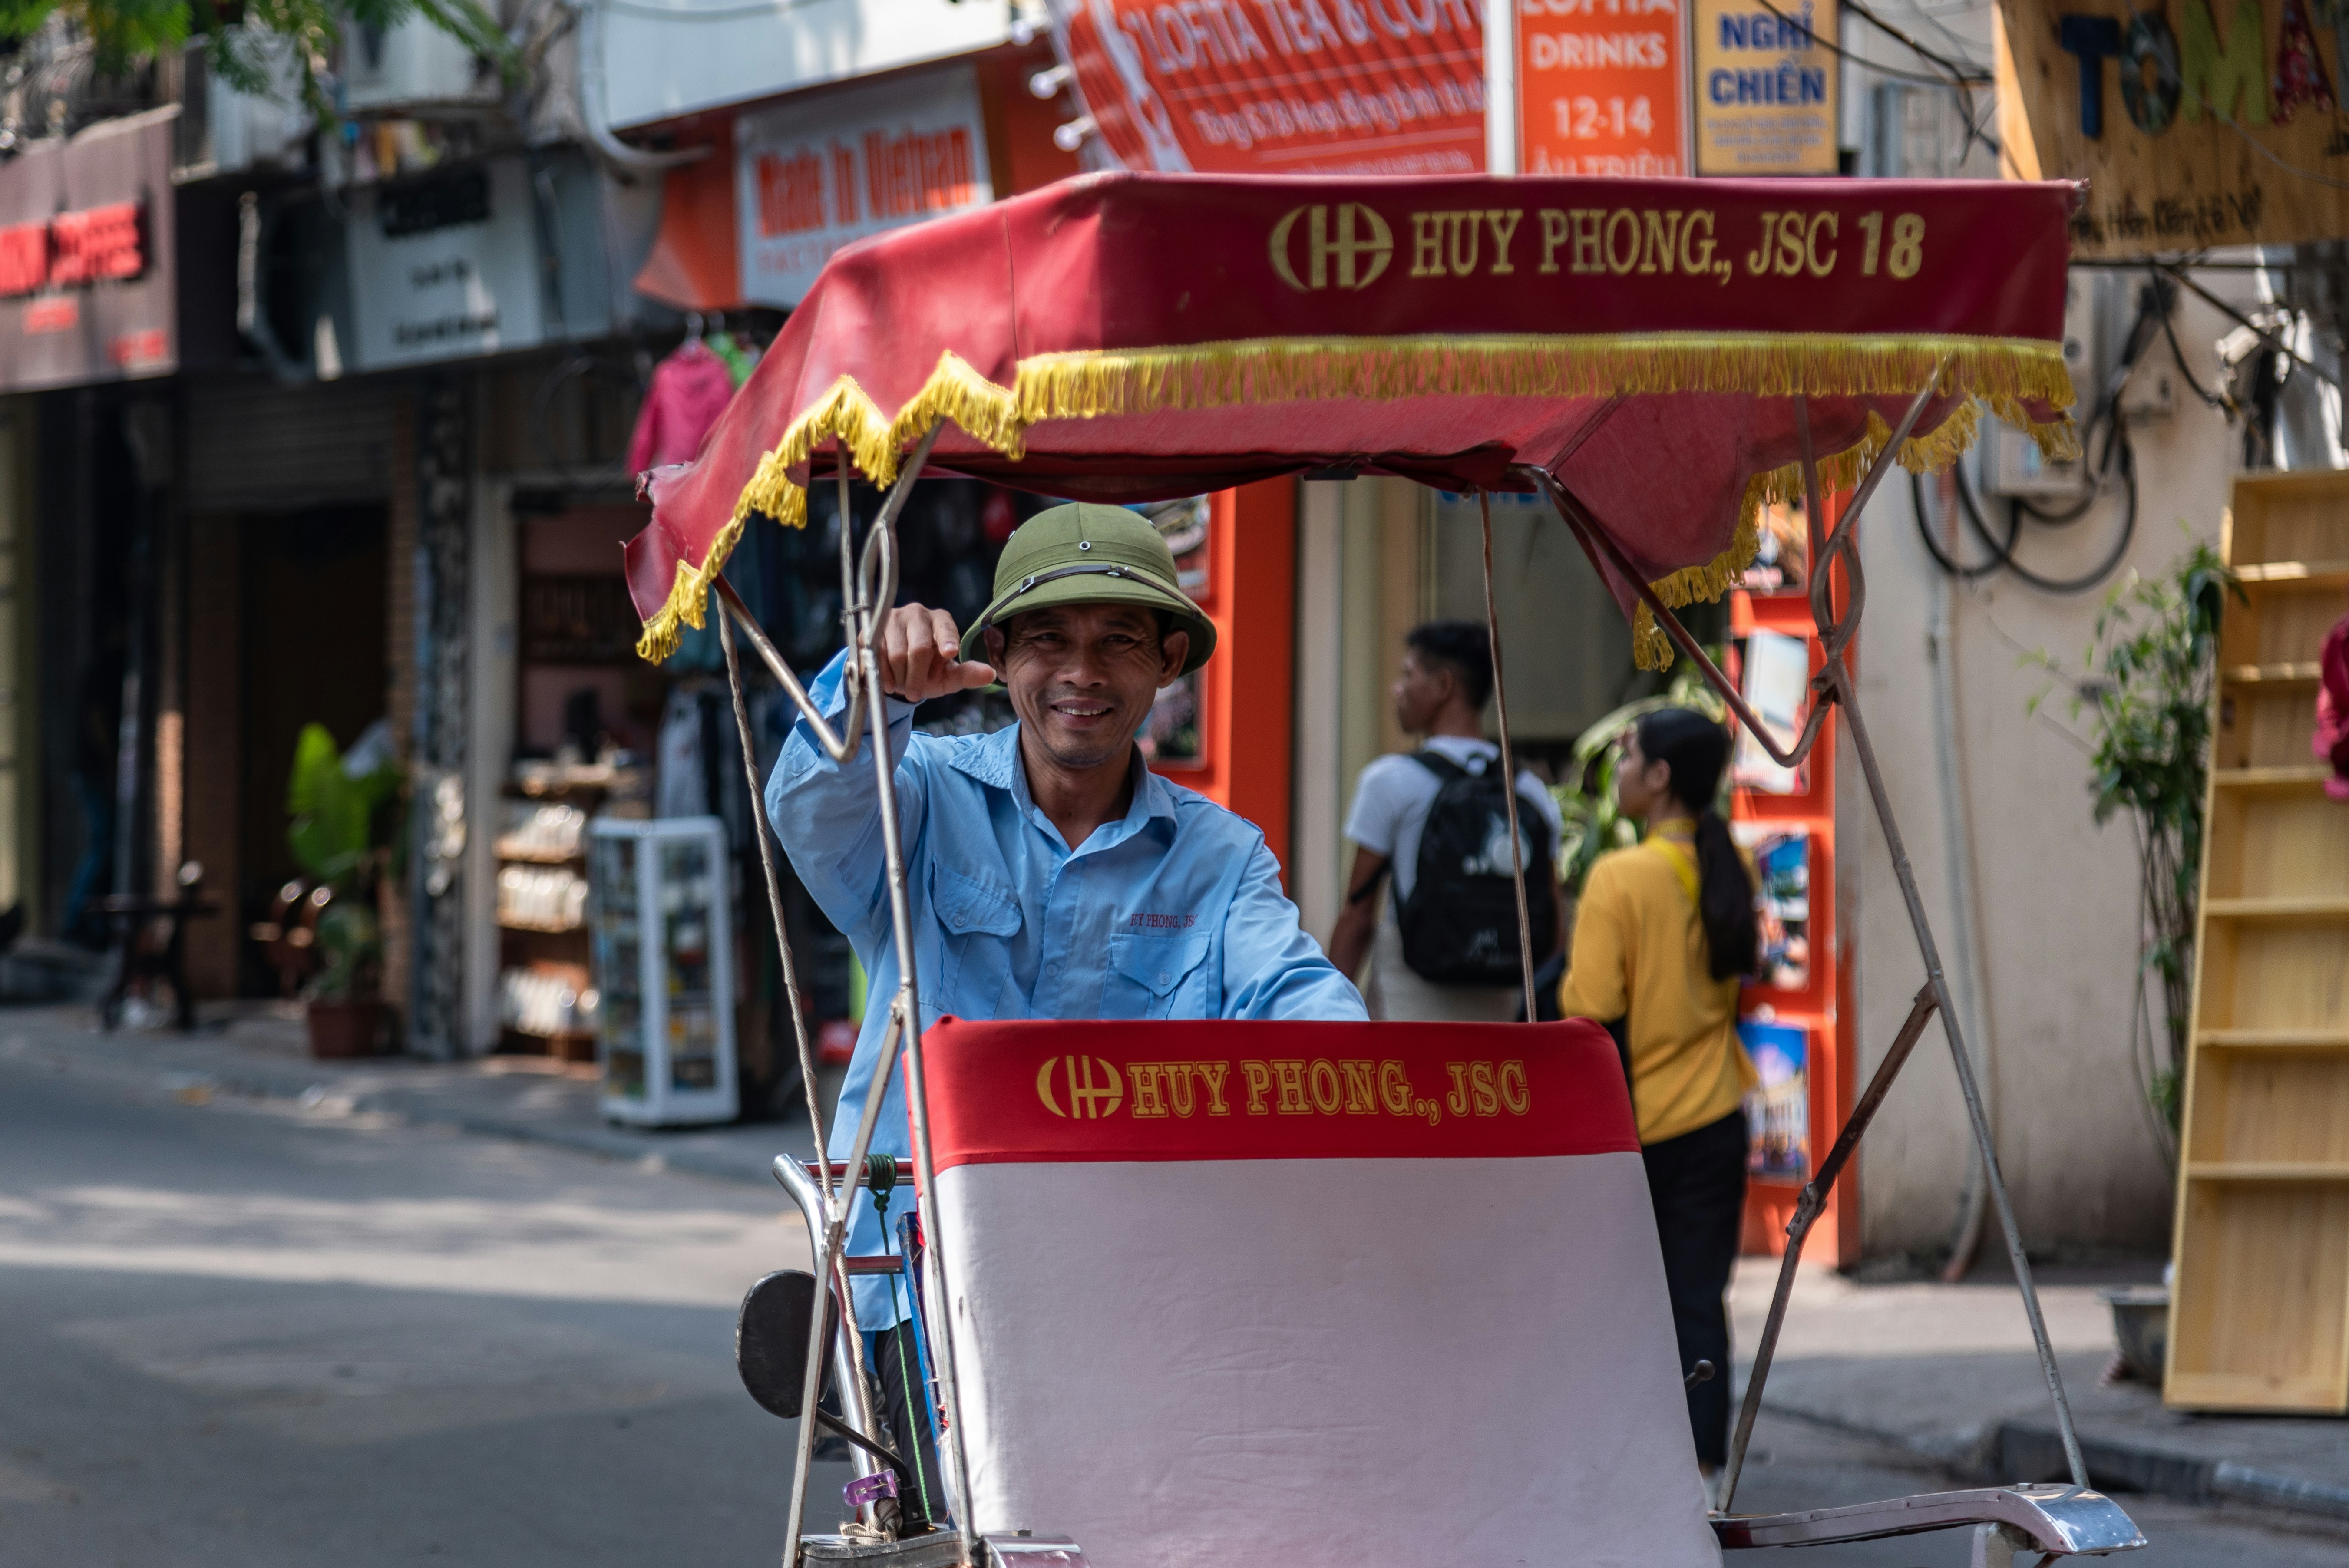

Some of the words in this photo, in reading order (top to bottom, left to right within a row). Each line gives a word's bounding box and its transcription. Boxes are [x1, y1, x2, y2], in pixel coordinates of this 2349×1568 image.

[1529, 31, 1668, 70] DRINKS
[1551, 96, 1655, 140] 12-14
[1409, 209, 1523, 277] HUY
[1746, 211, 1839, 277] JSC
[1858, 211, 1926, 279] 18
[1126, 1060, 1230, 1118] HUY
[1447, 1060, 1530, 1117] JSC
